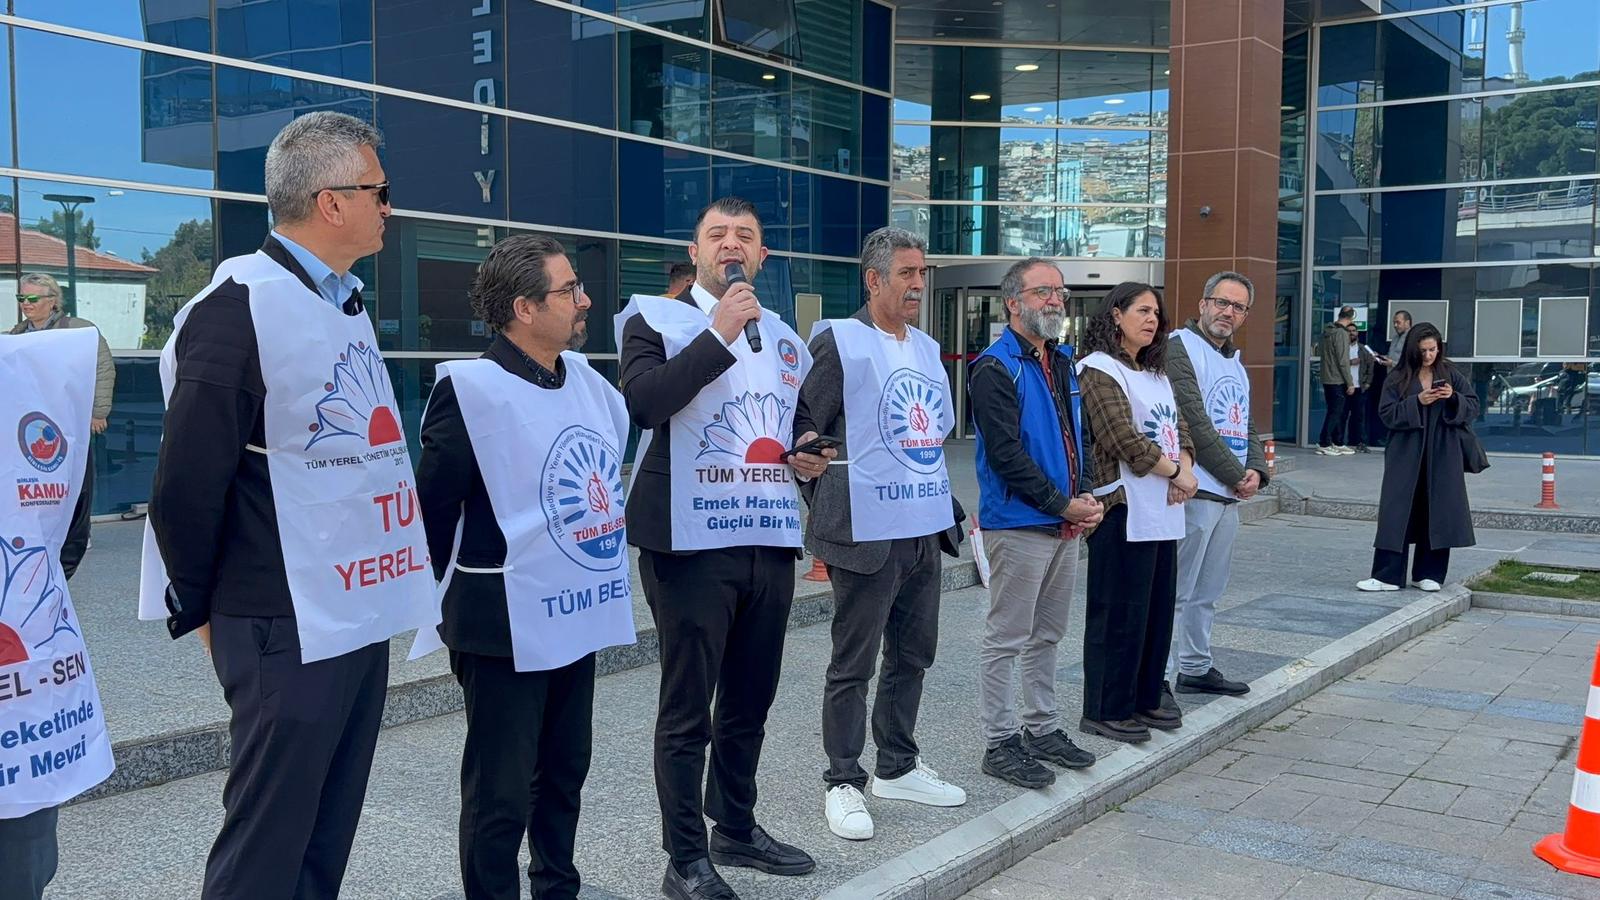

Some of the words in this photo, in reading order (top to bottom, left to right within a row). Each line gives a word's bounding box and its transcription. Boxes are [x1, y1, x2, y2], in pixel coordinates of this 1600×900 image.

[899, 436, 919, 448] TÜM
[305, 458, 328, 470] TÜM
[329, 456, 364, 468] YEREL
[549, 451, 563, 471] Yerel
[547, 473, 555, 484] ve
[695, 465, 734, 483] TÜM
[740, 468, 790, 483] YEREL
[874, 481, 914, 501] TÜM
[546, 485, 560, 522] Belediye
[692, 496, 740, 511] Emek
[706, 514, 754, 532] Güçlü
[759, 515, 783, 529] Bir
[573, 527, 599, 542] TÜM
[541, 588, 592, 618] TÜM
[52, 651, 86, 686] SEN
[29, 734, 87, 779] Mevzi
